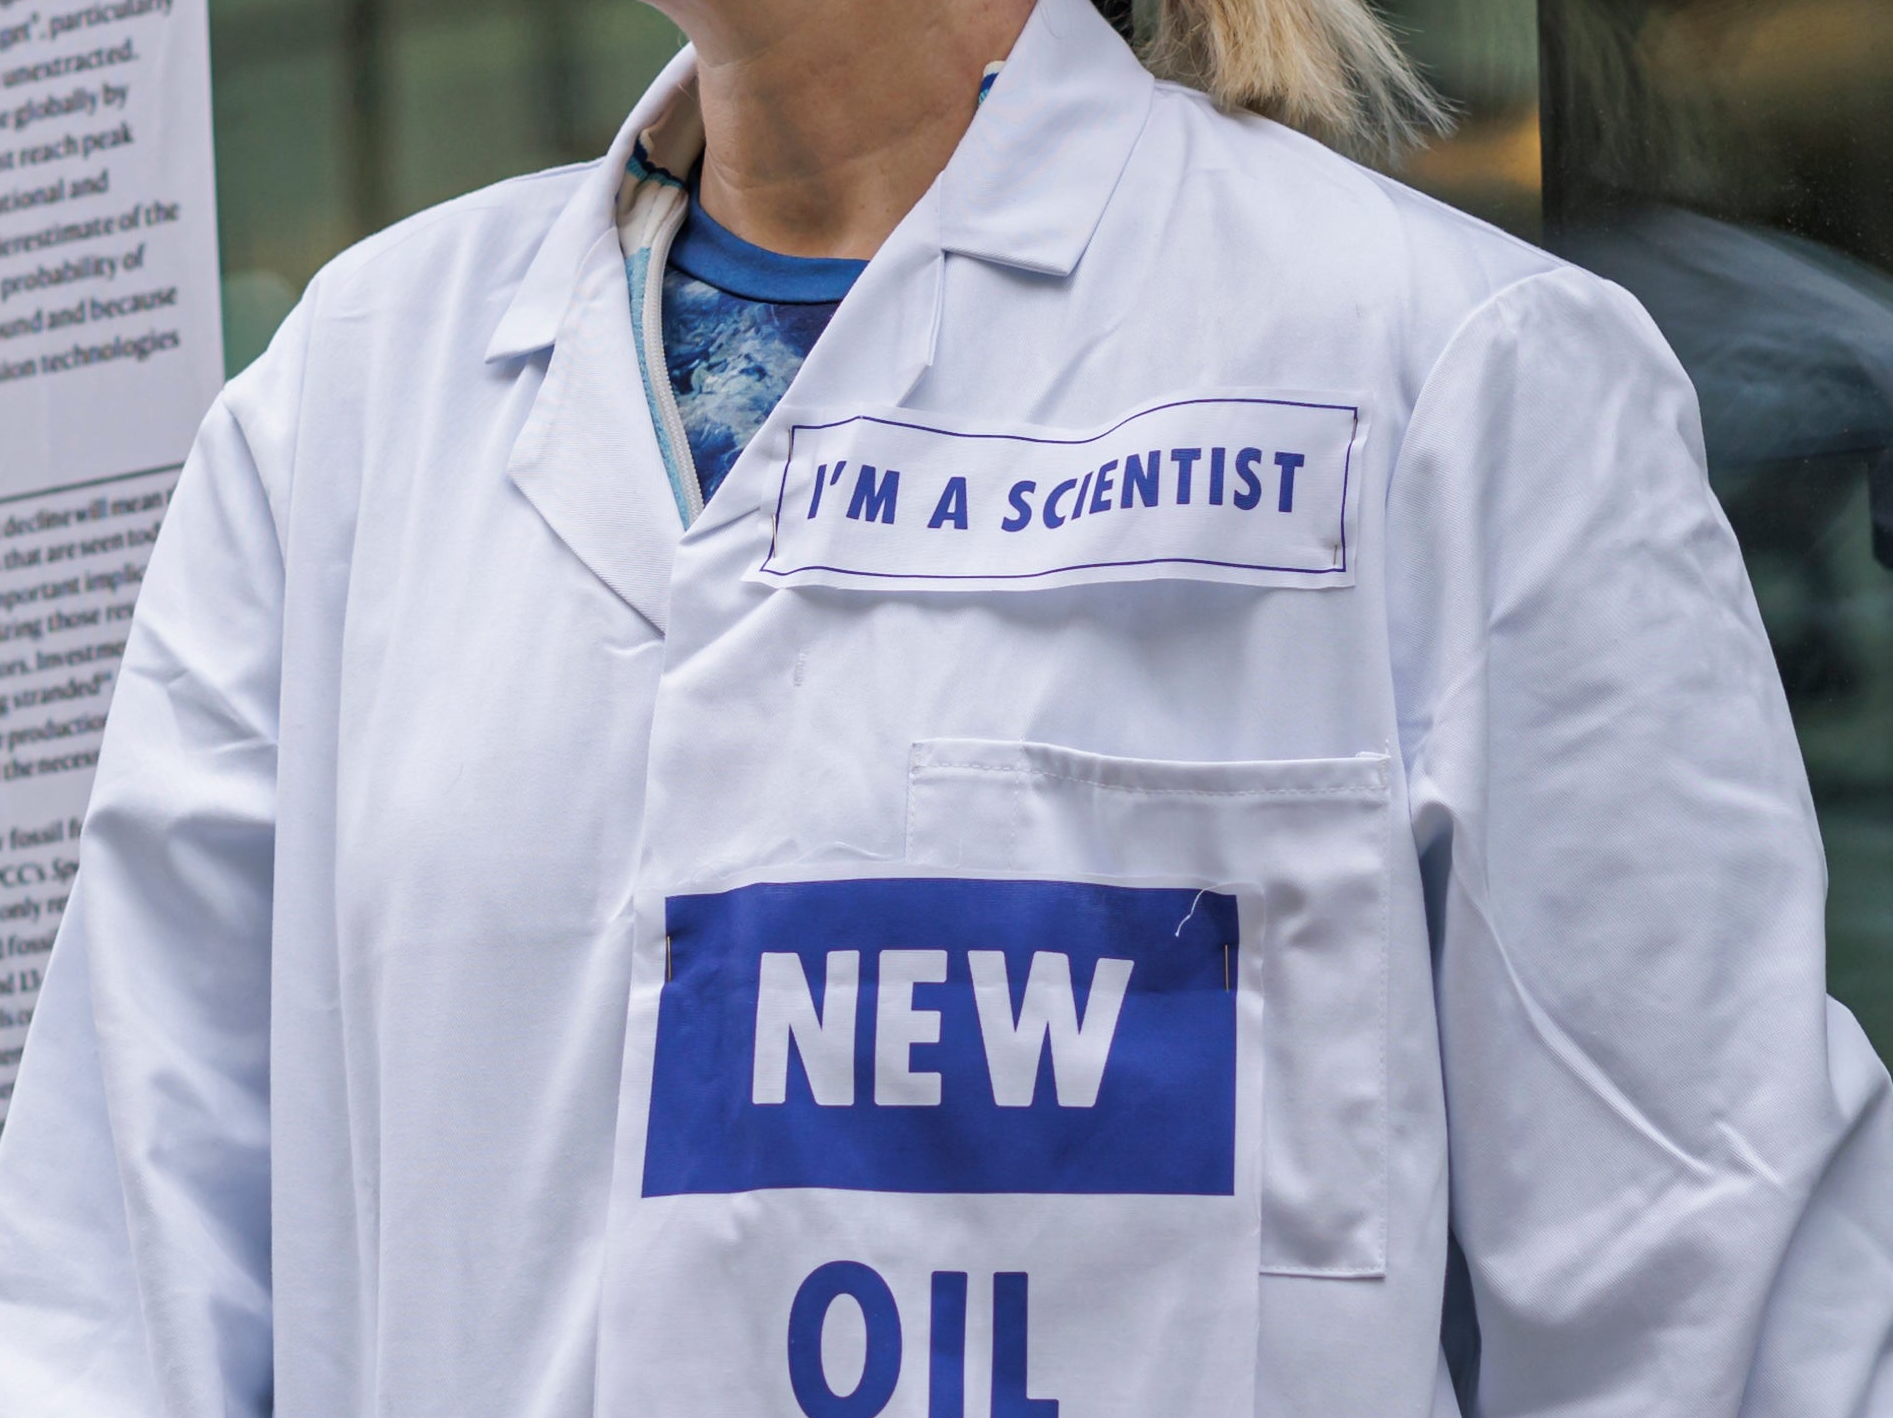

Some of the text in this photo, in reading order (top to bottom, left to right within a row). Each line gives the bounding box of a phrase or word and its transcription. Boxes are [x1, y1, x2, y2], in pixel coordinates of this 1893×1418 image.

[11, 87, 98, 131] globally
[100, 82, 128, 108] by
[18, 134, 80, 166] reach
[80, 122, 133, 158] peak
[68, 168, 109, 200] and
[143, 200, 179, 226] the
[0, 242, 145, 301] probability of
[46, 286, 177, 331] and because
[40, 330, 180, 373] technologies
[930, 478, 967, 529] A
[1003, 448, 1303, 531] SCIENTIST
[752, 949, 1134, 1108] NEW
